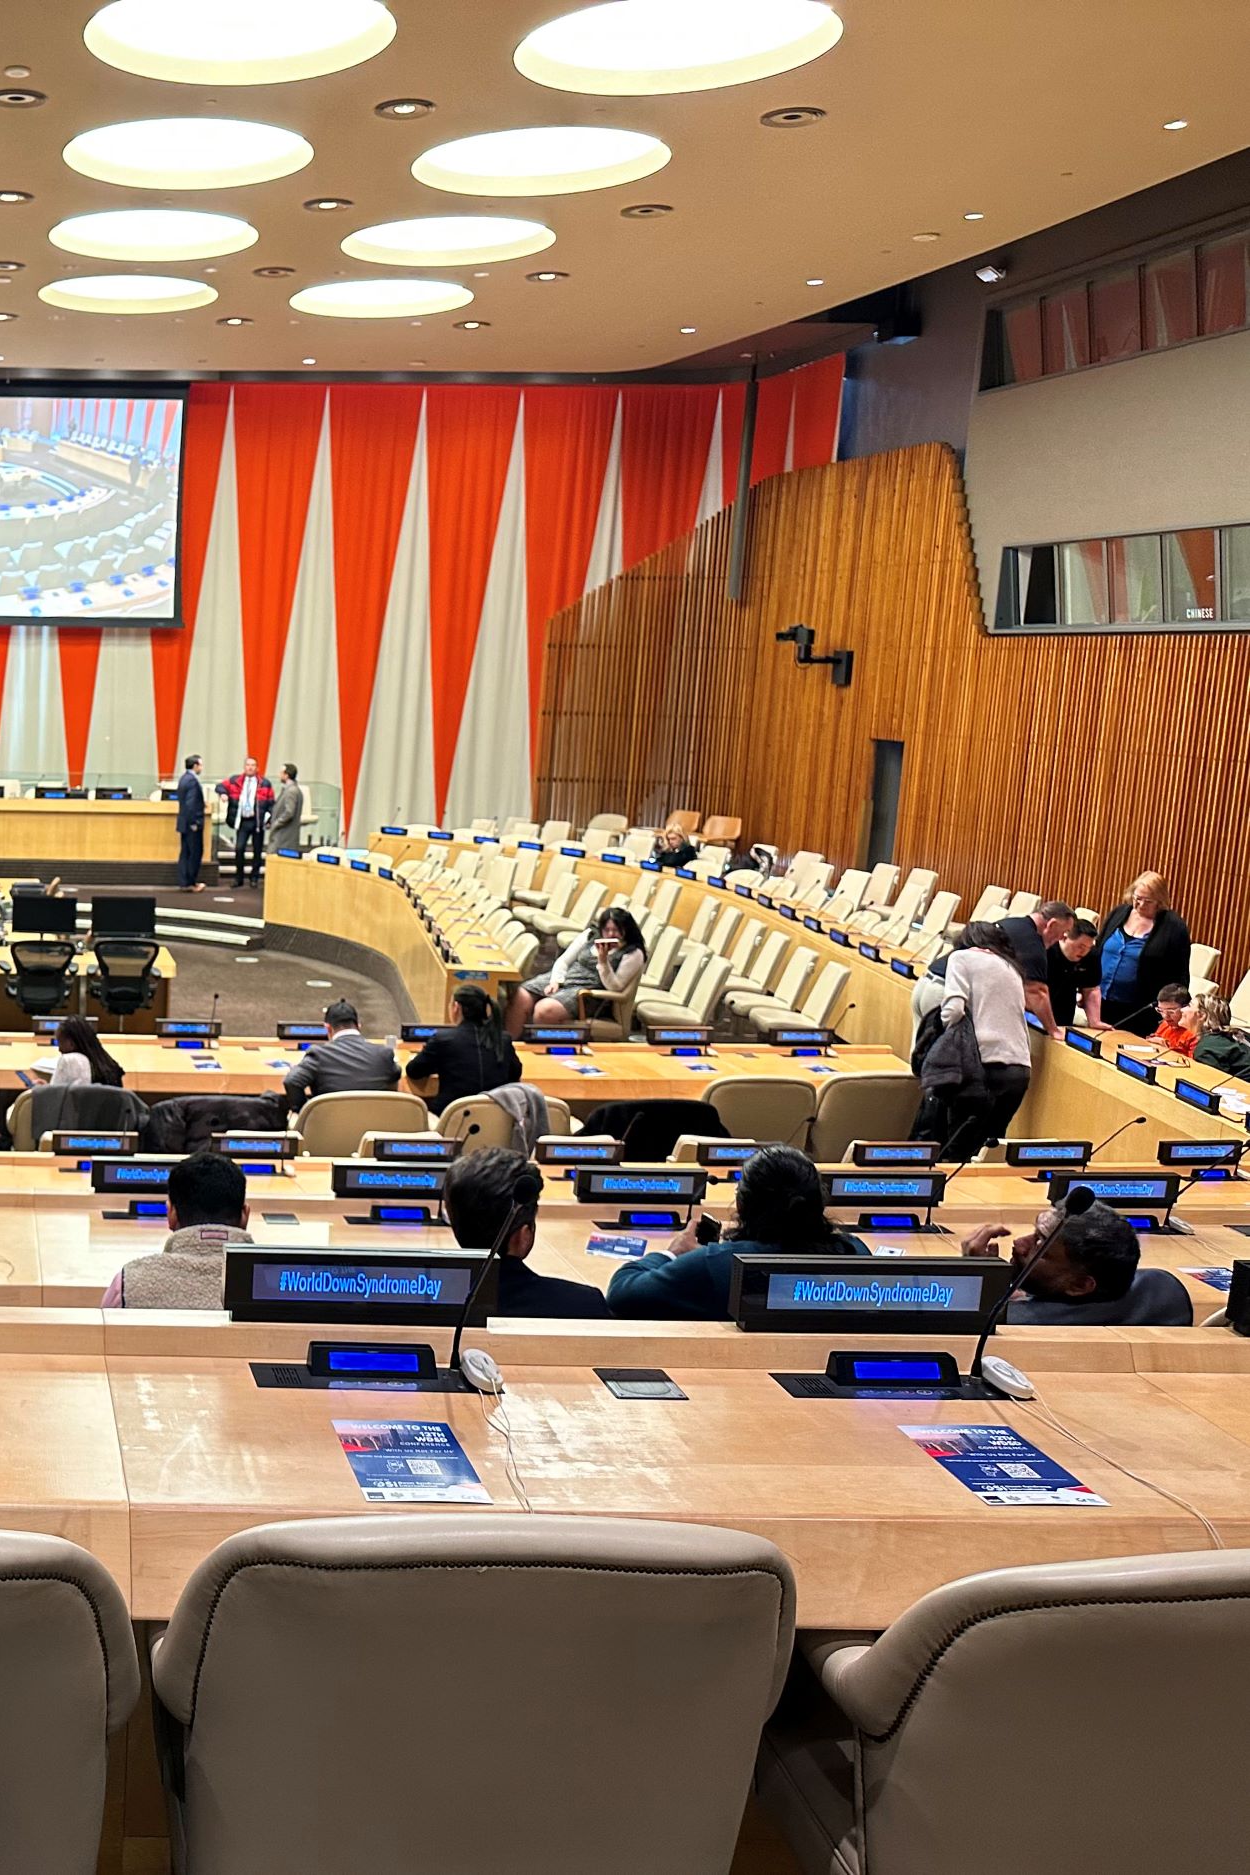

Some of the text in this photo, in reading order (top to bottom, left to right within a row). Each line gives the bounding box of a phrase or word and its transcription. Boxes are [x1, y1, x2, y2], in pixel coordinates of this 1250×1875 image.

[1186, 607, 1214, 619] CHINESE
[279, 1271, 442, 1301] #WorldDownSyndromeDay
[793, 1280, 955, 1307] #WorldDownSyndromeDay
